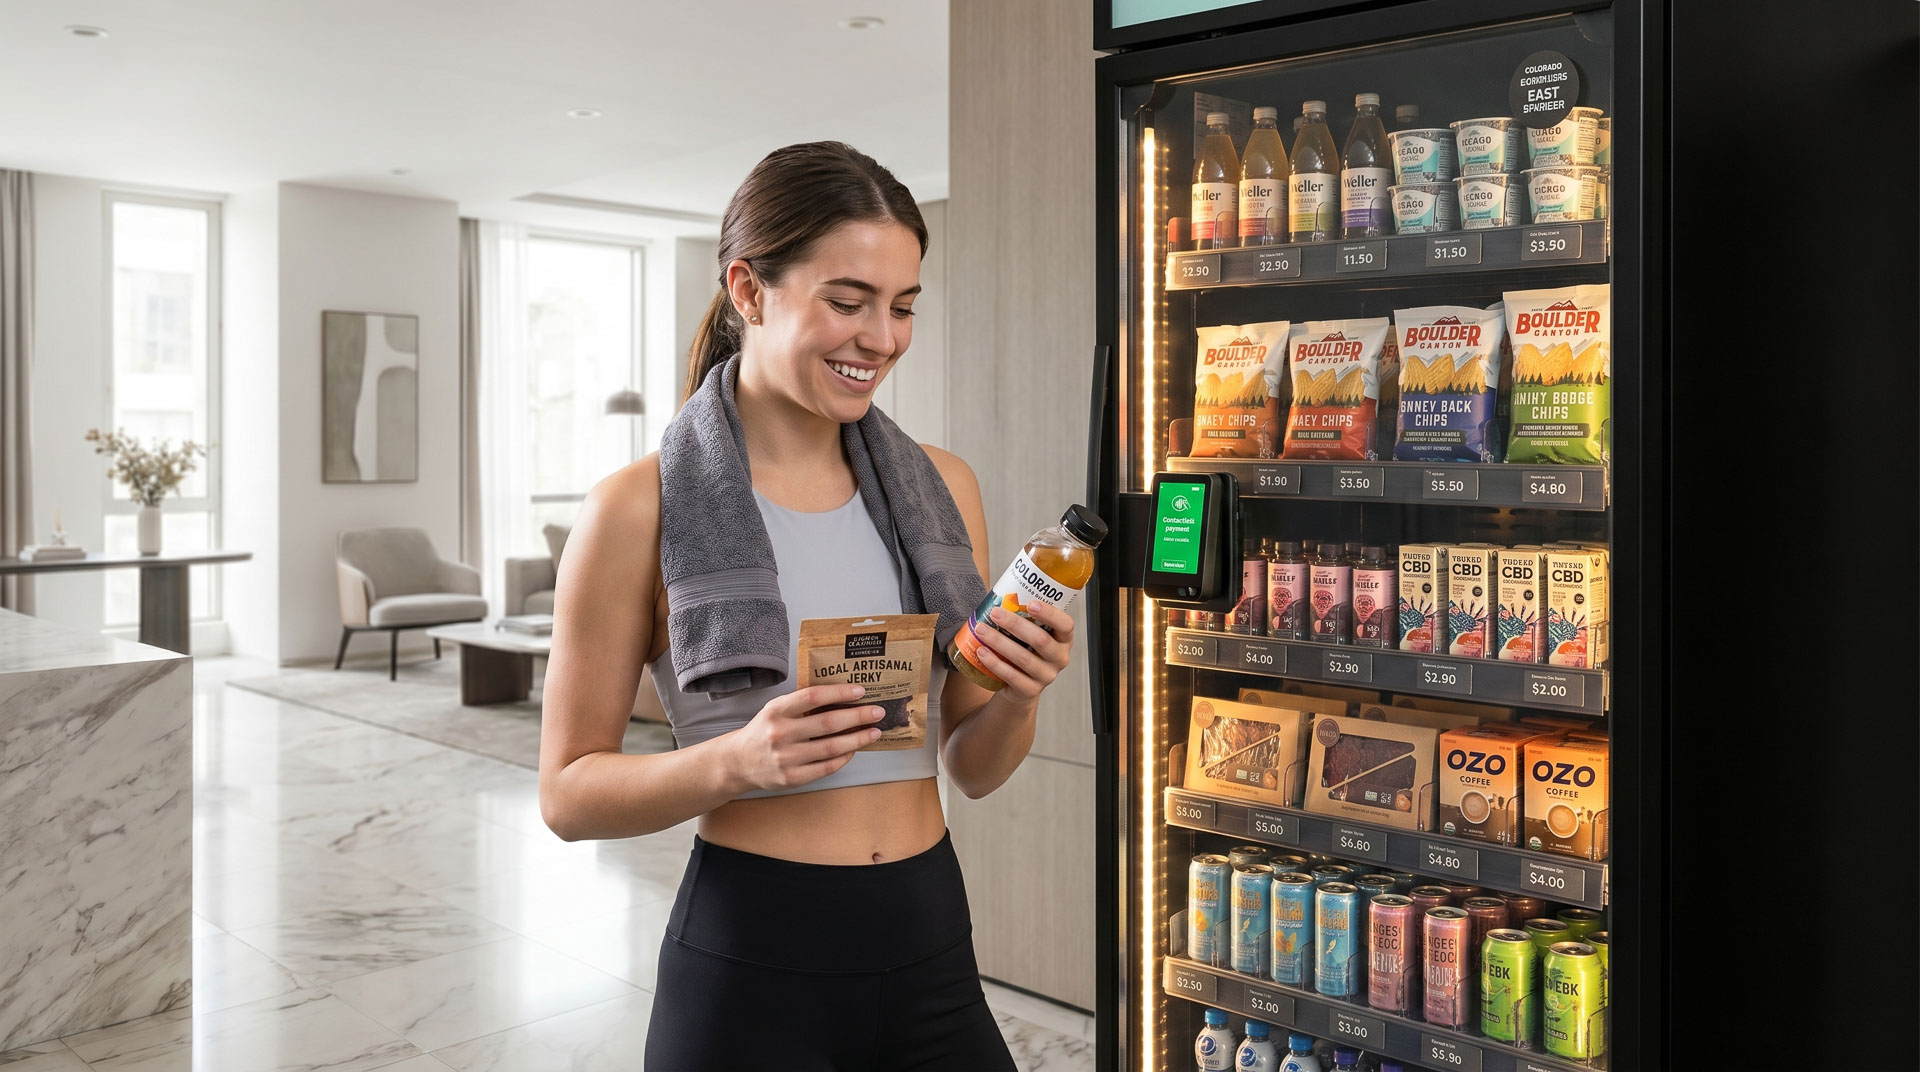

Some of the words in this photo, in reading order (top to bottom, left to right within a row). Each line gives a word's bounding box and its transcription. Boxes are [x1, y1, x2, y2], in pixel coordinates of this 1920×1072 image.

[1524, 62, 1562, 74] COLORADO
[1528, 86, 1560, 102] EAST
[1434, 246, 1467, 258] 31.50
[1260, 260, 1288, 272] 32.90
[1343, 253, 1373, 266] 11.50
[1516, 310, 1600, 335] BOULDER
[1404, 324, 1481, 347] BOULDER
[1203, 346, 1267, 366] BOULDER
[1294, 341, 1362, 363] BOULDER
[1441, 400, 1472, 413] BACK
[1532, 406, 1568, 420] CHIPS
[1228, 414, 1256, 427] CHIPS
[1322, 414, 1354, 427] CHIPS
[1415, 414, 1448, 427] CHIPS
[1260, 476, 1287, 487] $1.90
[1340, 477, 1370, 490] $3.50
[1431, 480, 1464, 492] $5.50
[1402, 560, 1432, 573] CBD
[1452, 563, 1482, 576] CBD
[1502, 566, 1534, 580] CBD
[1014, 558, 1064, 602] COLORADO
[1552, 570, 1584, 583] CBD
[1177, 643, 1204, 656] $2.00
[1246, 652, 1274, 665] $4.00
[814, 662, 848, 678] LOCAL
[853, 659, 913, 672] ARTISANAL
[1329, 660, 1359, 674] $2.90
[847, 672, 882, 684] JERKY
[1424, 671, 1456, 685] $2.90
[1532, 684, 1567, 696] $2.00
[1446, 748, 1506, 776] OZO
[1532, 760, 1596, 788] OZO
[1460, 776, 1491, 786] COFFEE
[1546, 788, 1579, 799] COFFEE
[1256, 820, 1284, 836] $5.00
[1530, 872, 1565, 890] $4.00
[1176, 976, 1202, 992] $2.50
[1251, 997, 1279, 1014] $2.00
[1338, 1021, 1368, 1038] $3.00
[1431, 1047, 1462, 1066] $5.90
